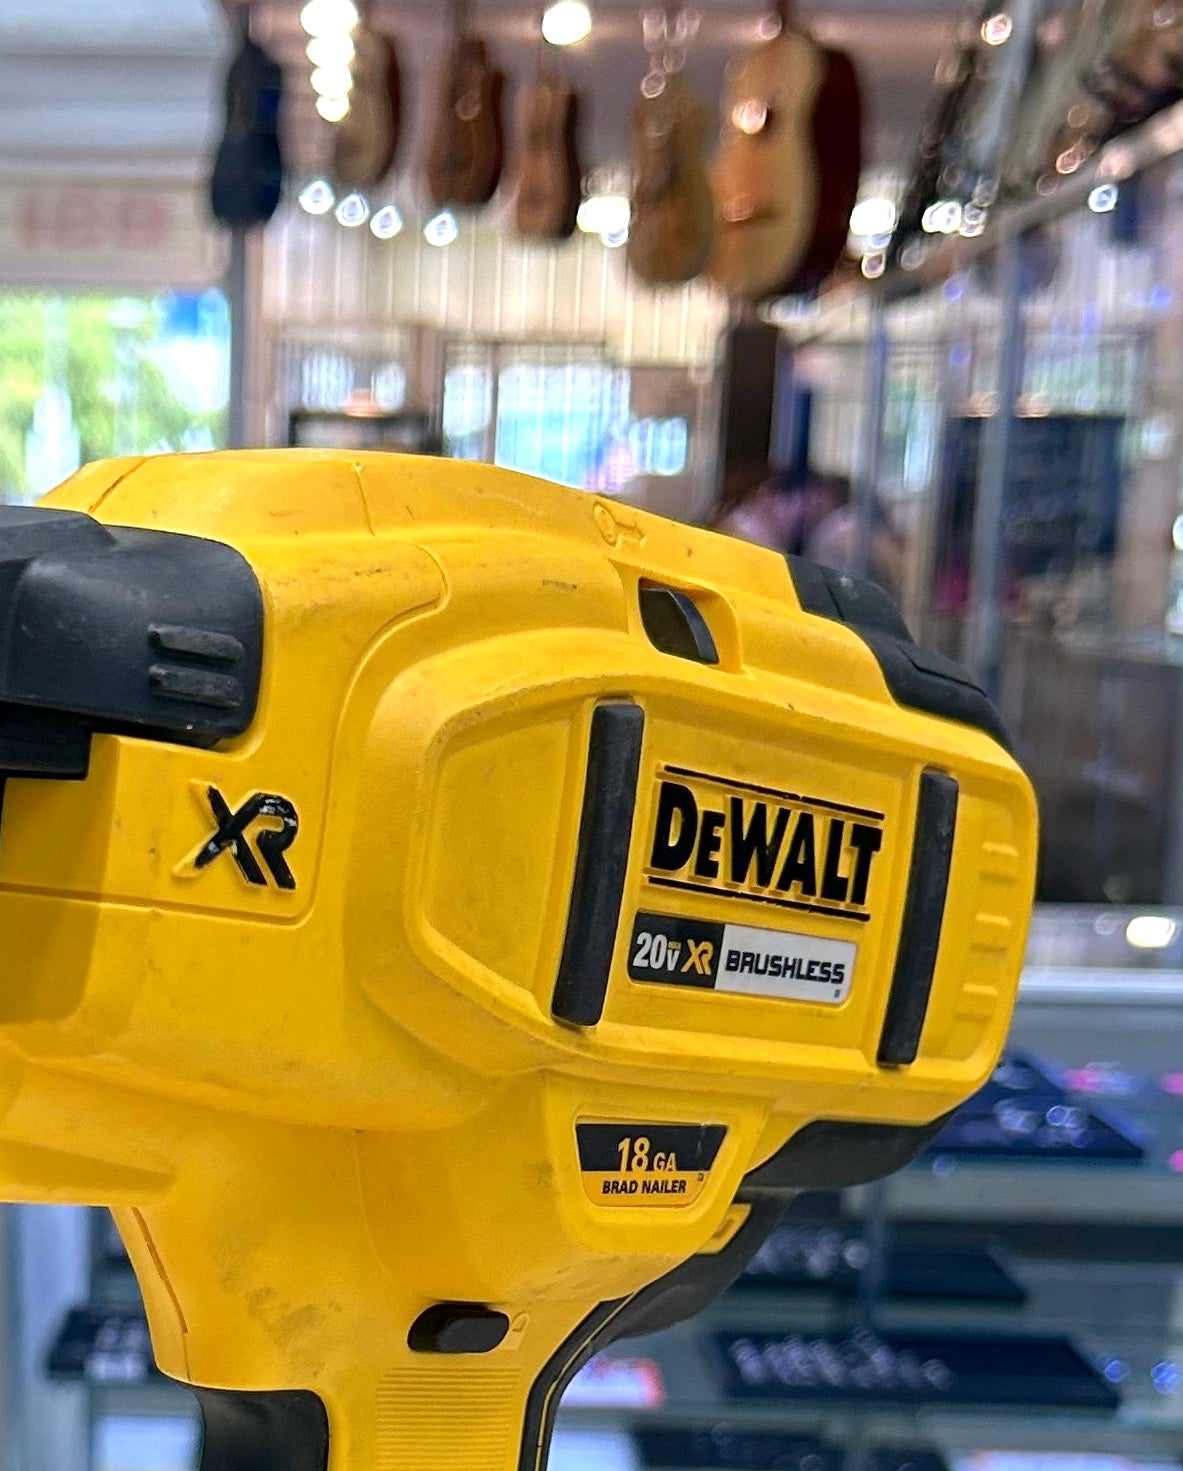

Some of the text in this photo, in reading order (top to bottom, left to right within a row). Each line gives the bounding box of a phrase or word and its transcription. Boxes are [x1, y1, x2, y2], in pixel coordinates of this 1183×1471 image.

[192, 784, 299, 890] XR
[681, 938, 713, 977] XR
[724, 949, 846, 985] BRUSHLESS
[617, 1136, 678, 1172] 18 GA
[601, 1179, 687, 1195] BRAD NAILER
